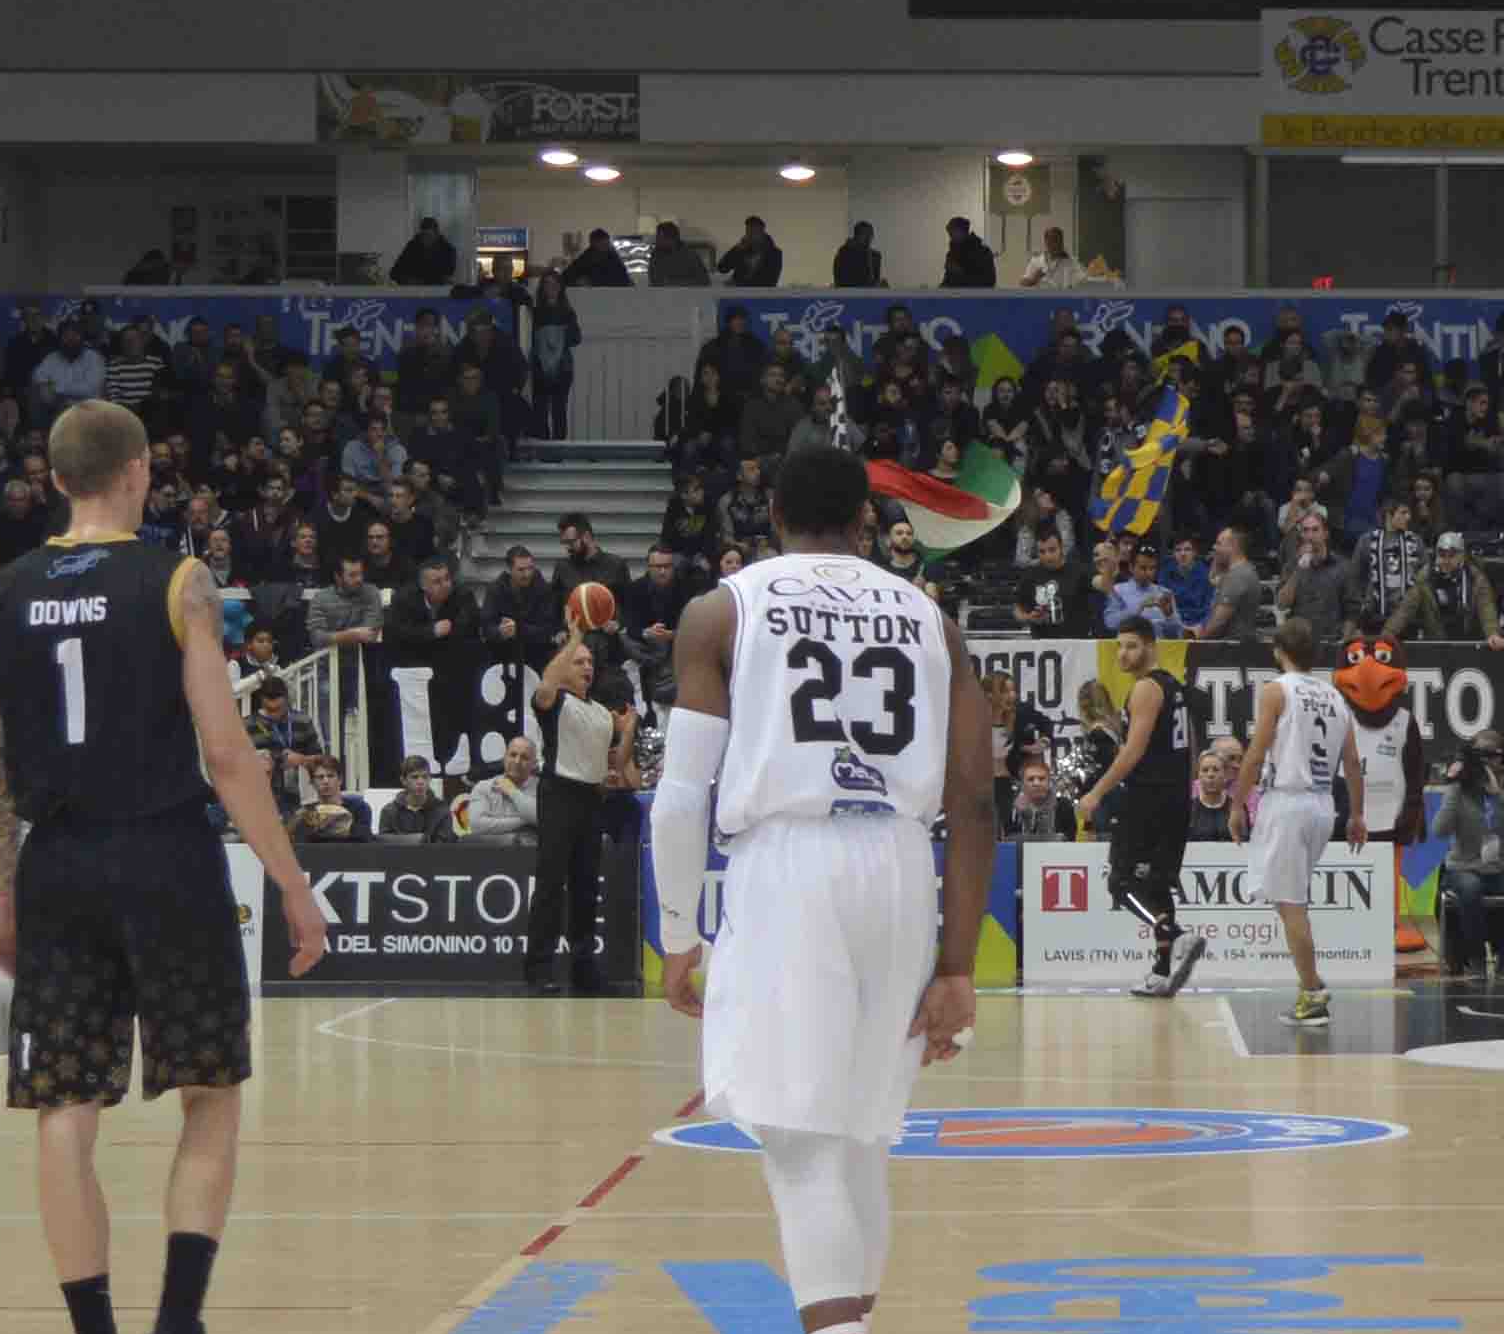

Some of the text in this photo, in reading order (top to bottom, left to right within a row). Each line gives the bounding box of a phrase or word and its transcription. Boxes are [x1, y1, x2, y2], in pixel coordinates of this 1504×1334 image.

[1369, 17, 1486, 57] Casse
[531, 92, 637, 121] FORST
[29, 596, 108, 626] DOWNS
[766, 605, 923, 645] SUTTON
[56, 637, 87, 745] 1
[786, 637, 916, 757] 23
[336, 935, 513, 954] DEL SIMONINO 10
[1227, 916, 1280, 945] oggi
[1043, 948, 1144, 964] LAVIS (TN) Via
